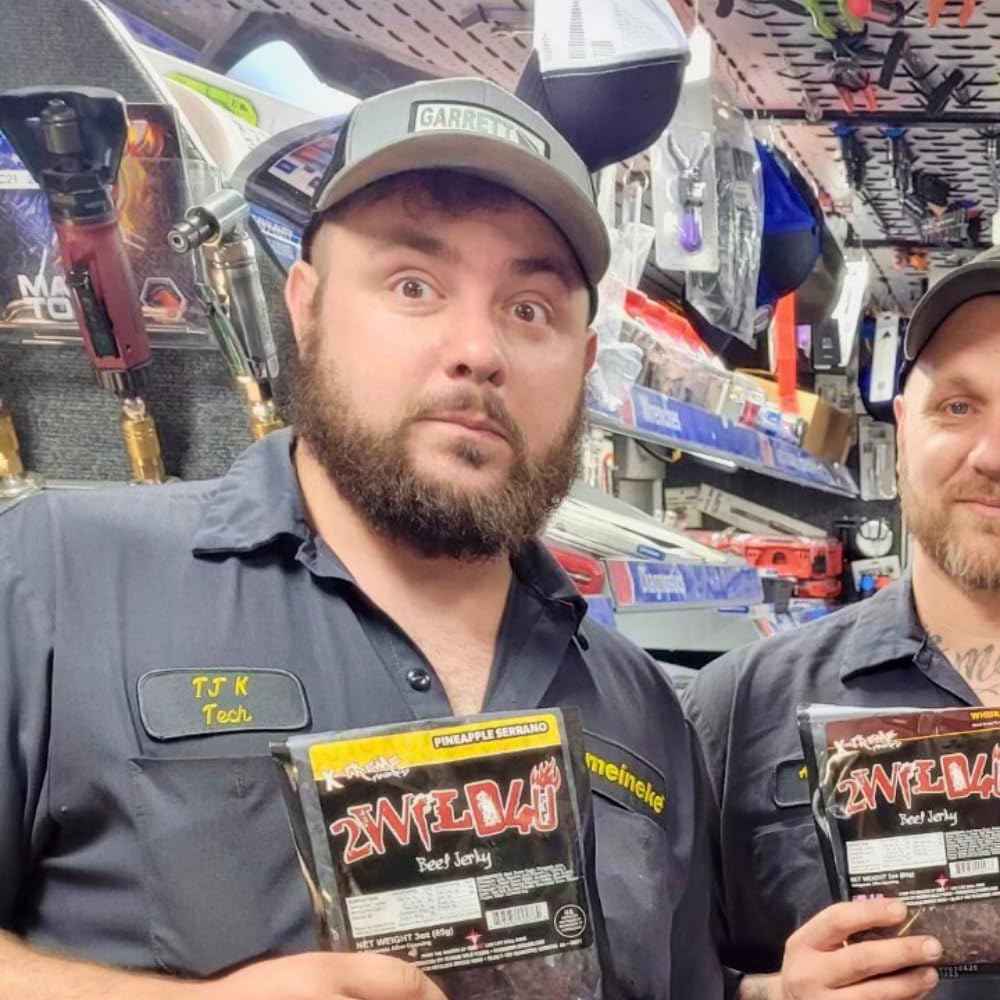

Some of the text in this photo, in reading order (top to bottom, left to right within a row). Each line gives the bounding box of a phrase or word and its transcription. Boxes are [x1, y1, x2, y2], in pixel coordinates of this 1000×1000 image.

[202, 703, 253, 725] Tech
[433, 722, 548, 749] PINEAPPLE SERRANO
[584, 752, 665, 814] meineke
[899, 808, 958, 826] Beef Jerky
[416, 848, 493, 873] Beef Jerky
[356, 940, 374, 950] NET
[376, 932, 412, 947] WEIGHT
